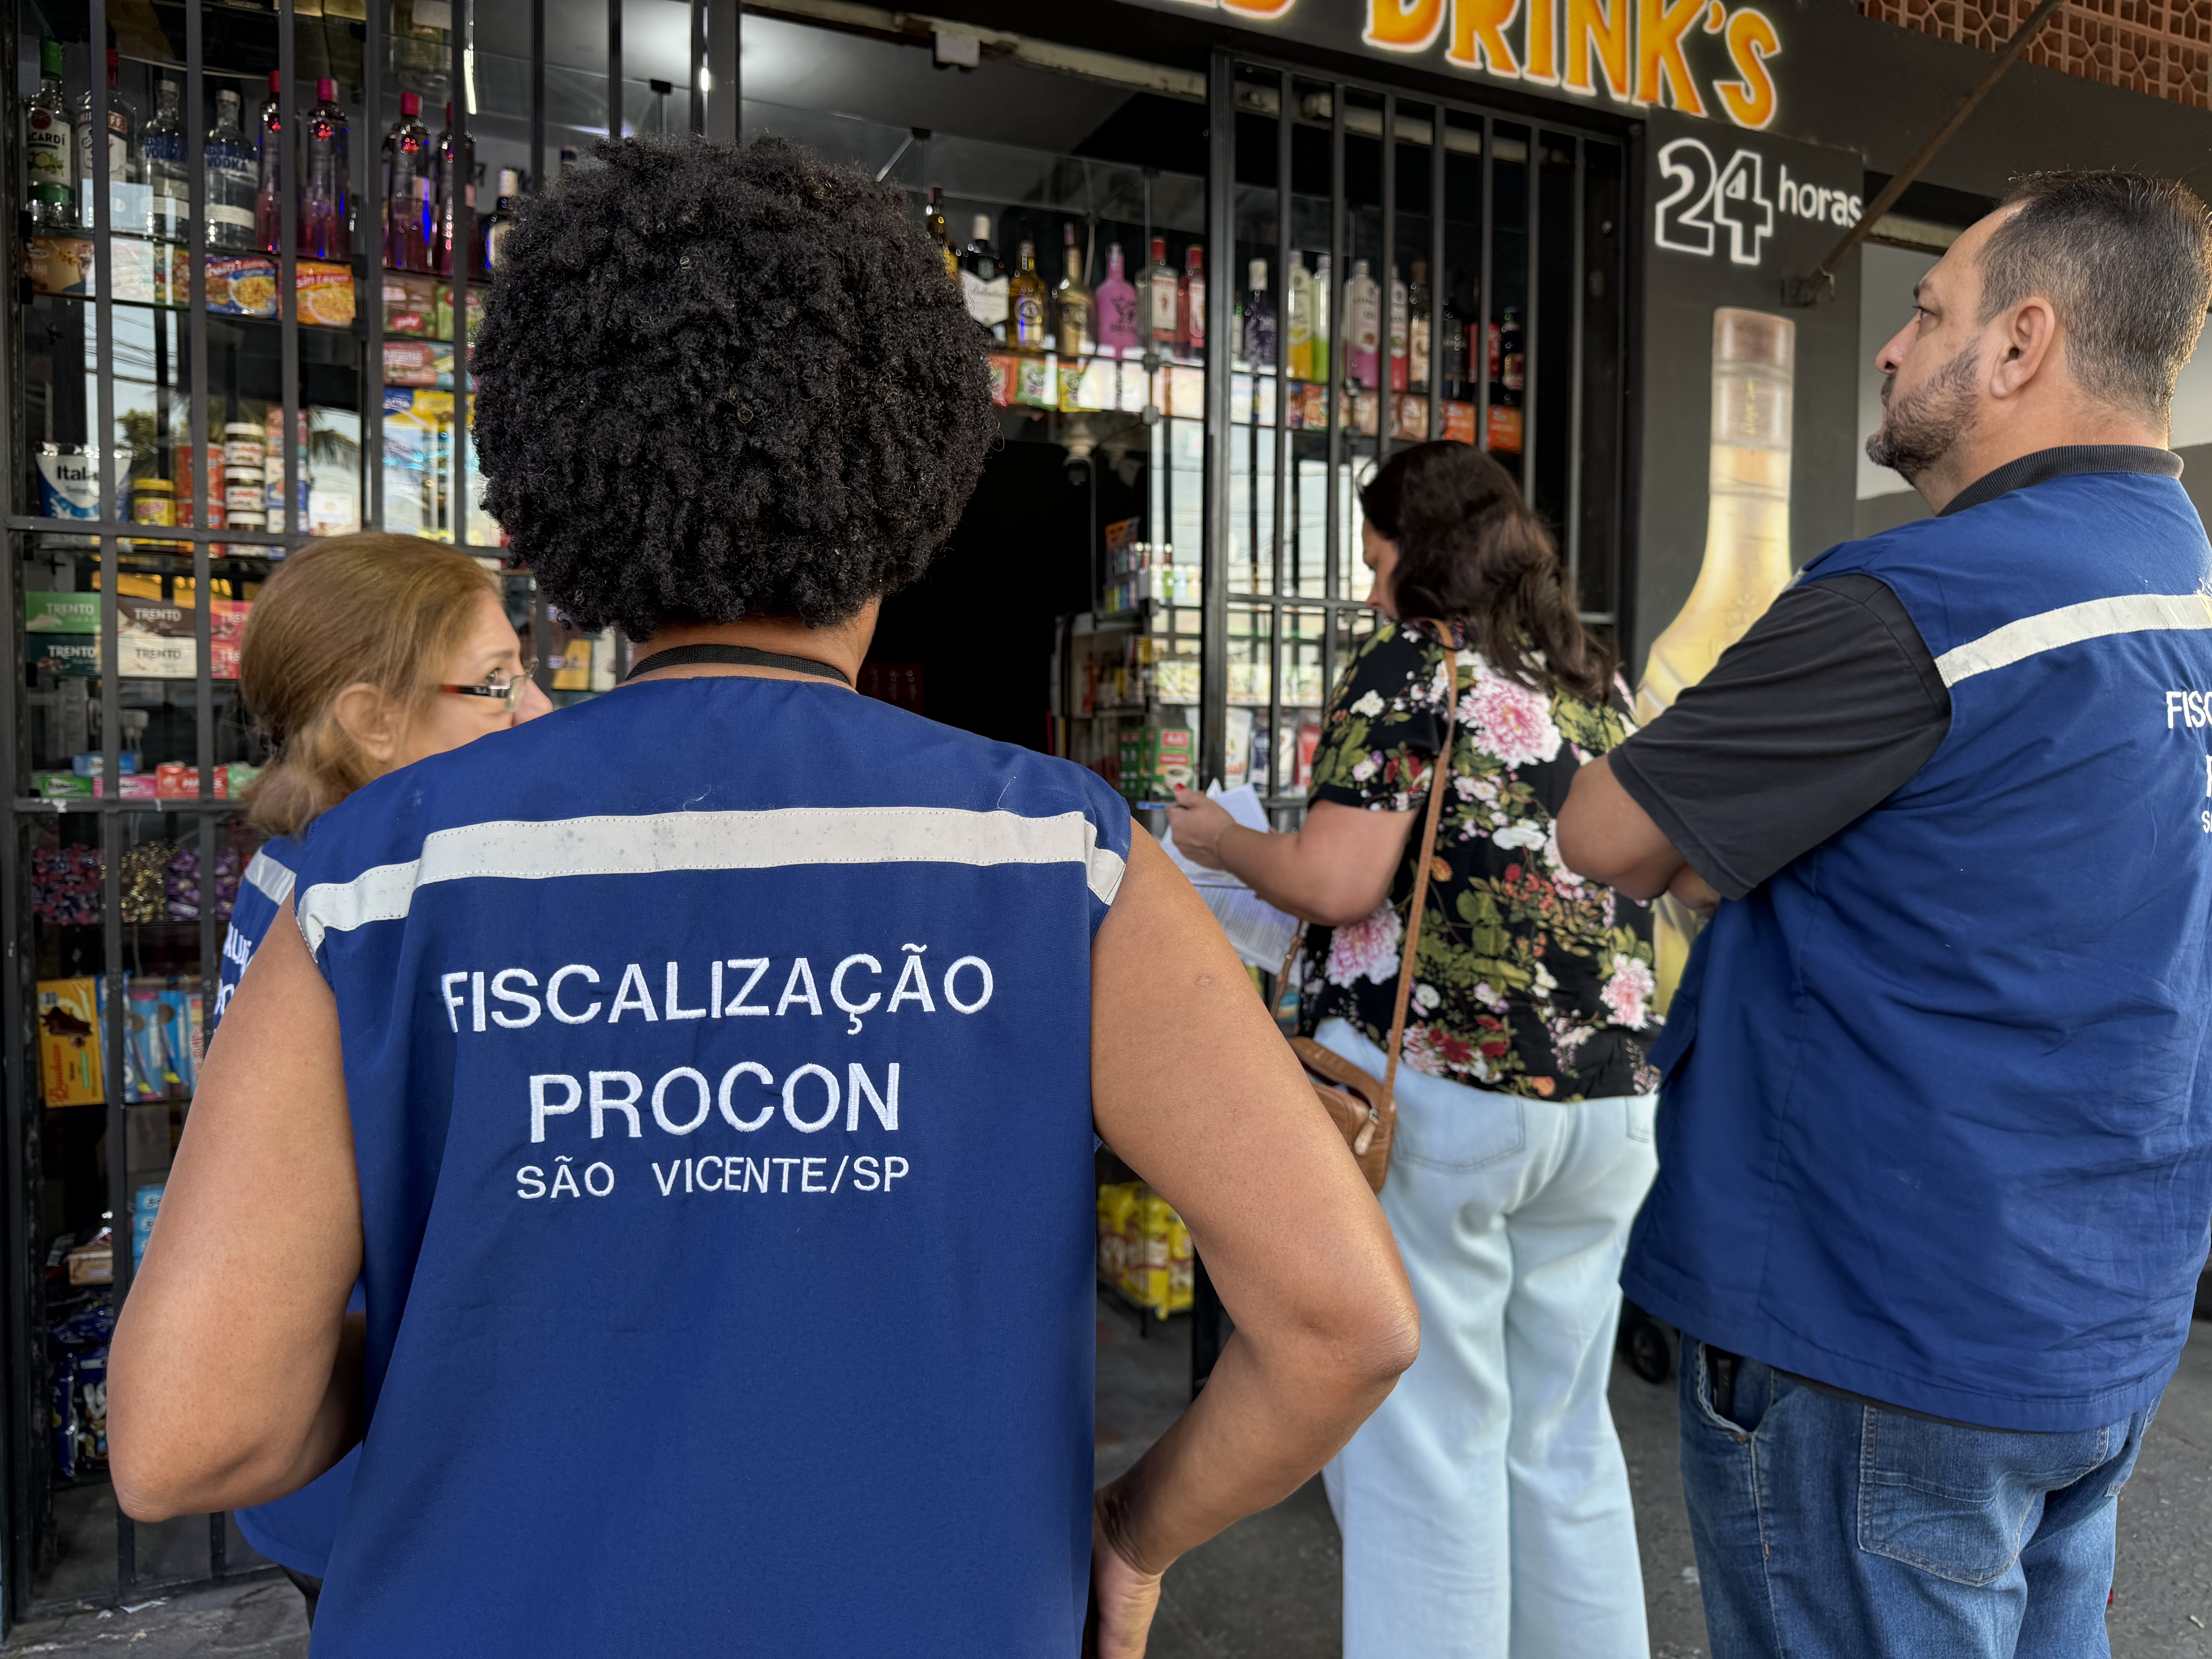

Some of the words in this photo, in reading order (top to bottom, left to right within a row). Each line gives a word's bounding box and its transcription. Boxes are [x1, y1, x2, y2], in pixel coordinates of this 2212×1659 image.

[1655, 137, 1773, 265] 24
[1779, 164, 1862, 228] horas
[46, 603, 94, 616] TRENTO
[134, 607, 182, 622] TRENTO
[47, 645, 96, 659] TRENTO
[135, 647, 182, 661] TRENTO
[441, 943, 994, 1035] FISCALIZAÇÃO
[529, 1061, 900, 1143] PROCON
[516, 1156, 615, 1200] SÃO
[652, 1155, 910, 1197] VICENTE/SP
